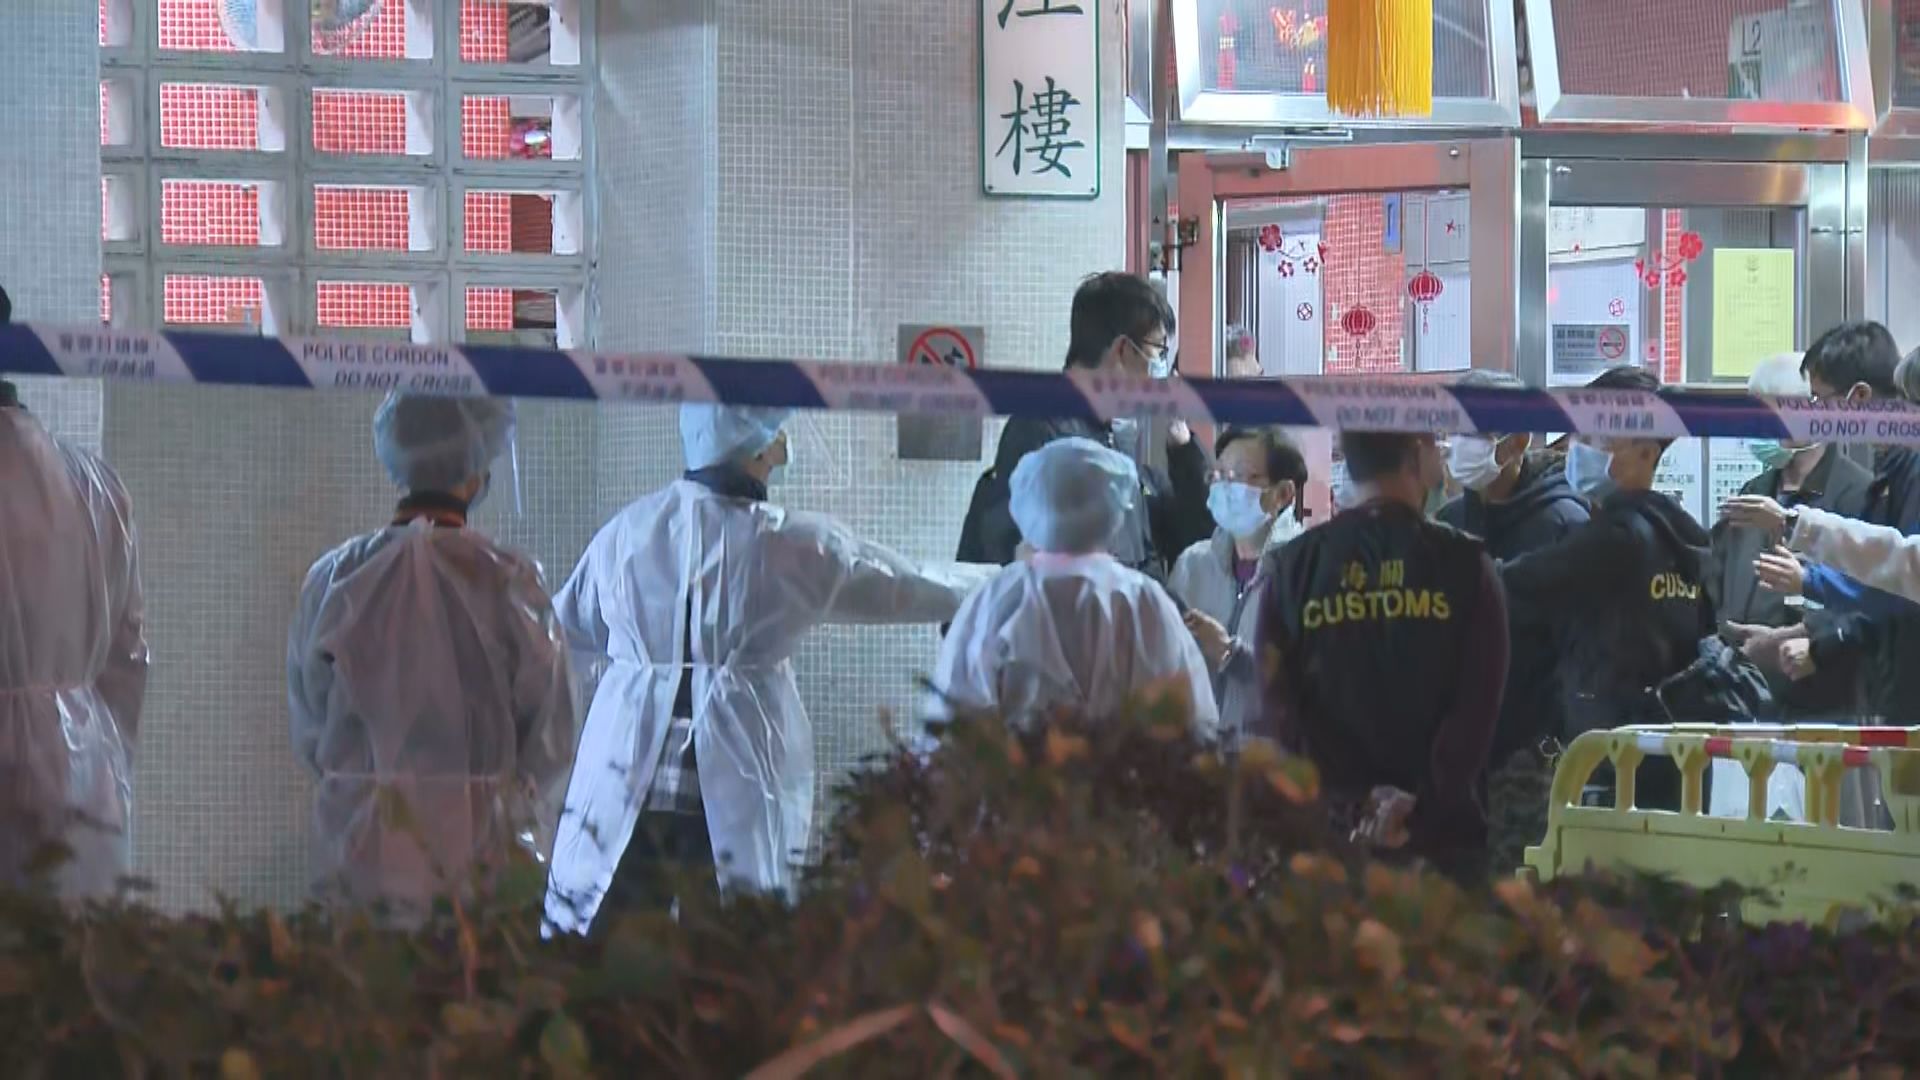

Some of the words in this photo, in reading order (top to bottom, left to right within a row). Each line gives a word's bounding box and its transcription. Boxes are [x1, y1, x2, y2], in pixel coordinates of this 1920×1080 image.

[303, 342, 367, 364] POLICE
[372, 345, 449, 367] CORDON
[334, 369, 361, 387] DO
[364, 371, 401, 389] NOT
[1809, 420, 1833, 436] DO
[1836, 420, 1867, 437] NOT
[1303, 588, 1451, 629] CUSTOMS
